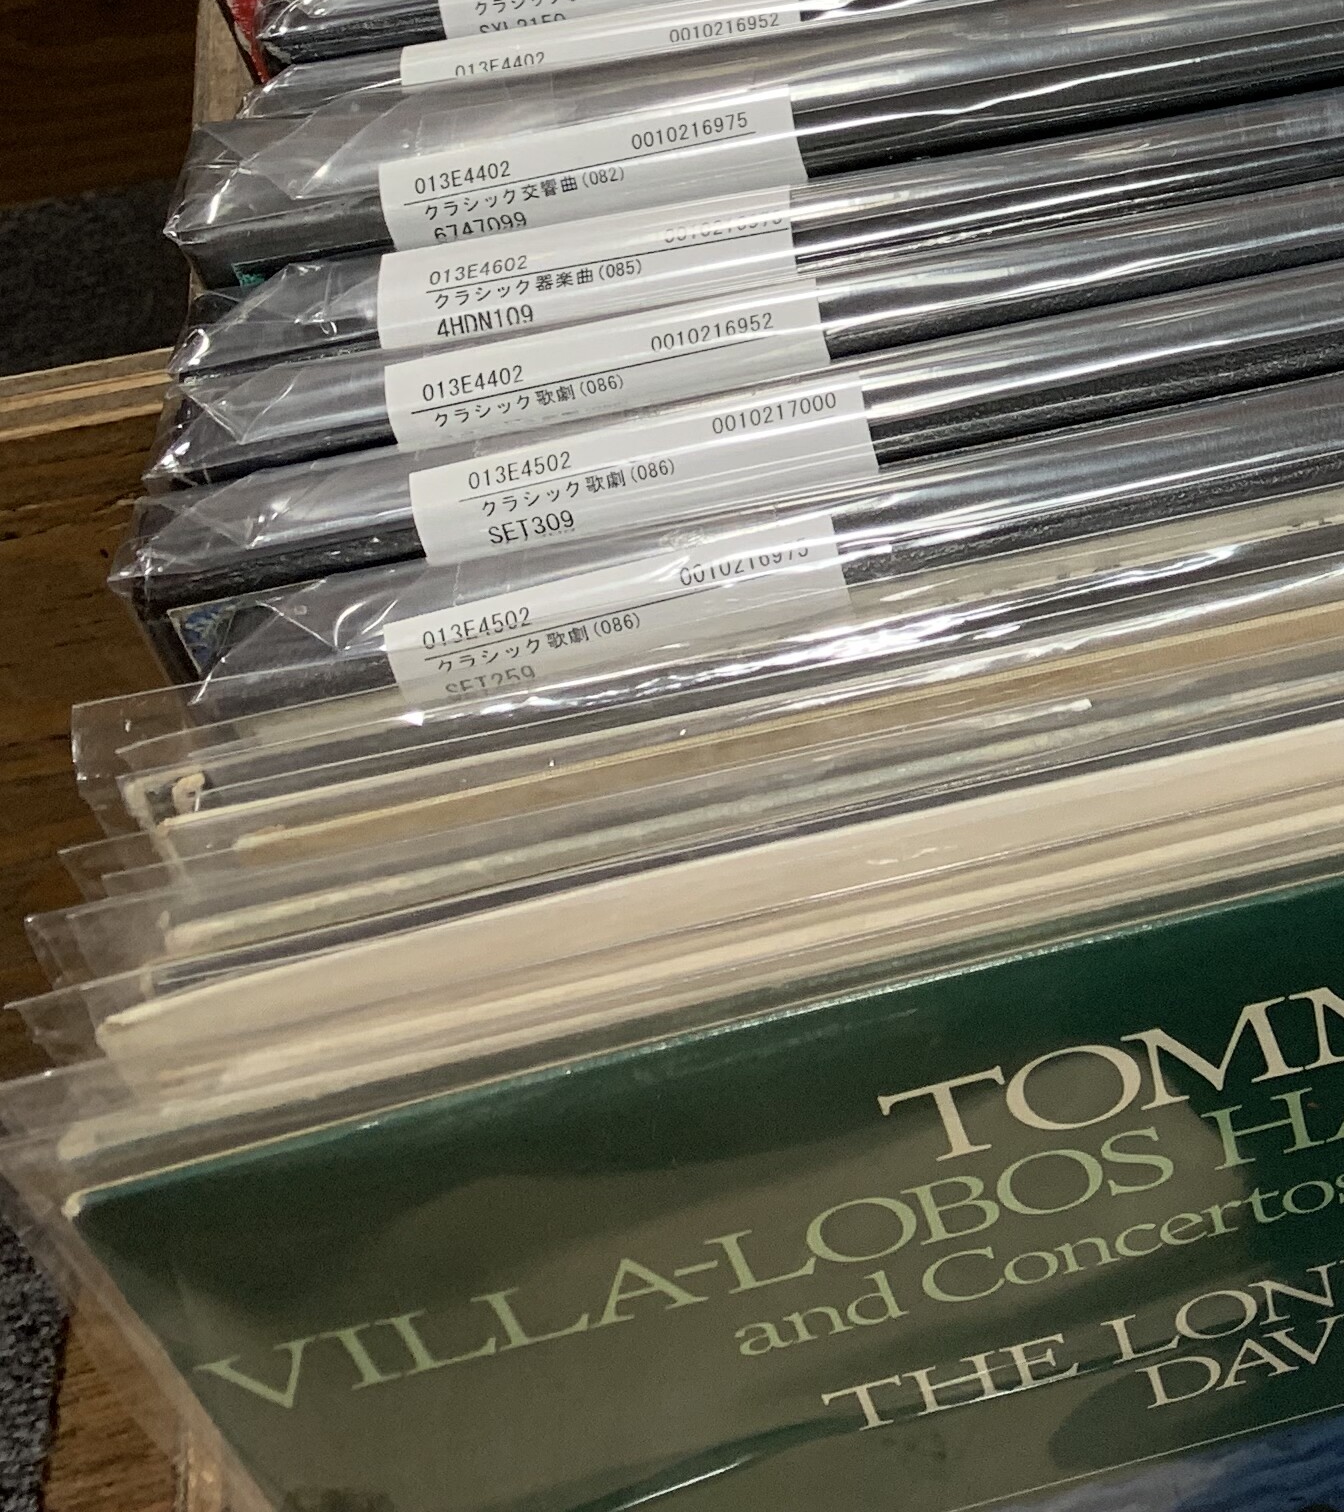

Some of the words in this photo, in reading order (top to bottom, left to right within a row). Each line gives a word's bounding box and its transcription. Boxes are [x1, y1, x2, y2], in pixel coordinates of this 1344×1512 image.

[669, 12, 780, 44] 0010216952
[414, 160, 512, 195] 013E4402
[631, 111, 748, 150] 0010216975
[423, 165, 626, 222] クラシック交響曲(082)
[429, 255, 528, 286] 013E4602
[434, 258, 643, 310] クラシック器楽曲(085)
[422, 364, 525, 402] 013E4402
[650, 312, 774, 352] 0010216952
[434, 373, 625, 428] クラシック歌劇(086)
[467, 450, 573, 490] 013E4502
[711, 390, 837, 435] 0010217000
[481, 457, 676, 517] クラシック歌劇(086)
[488, 508, 575, 546] SET309
[422, 606, 532, 650] 013E4502
[438, 611, 641, 672] クラシック歌劇(086)
[198, 1125, 1177, 1410] VILLA-LOBOS
[733, 1271, 907, 1356] and
[821, 1333, 1079, 1432] THE
